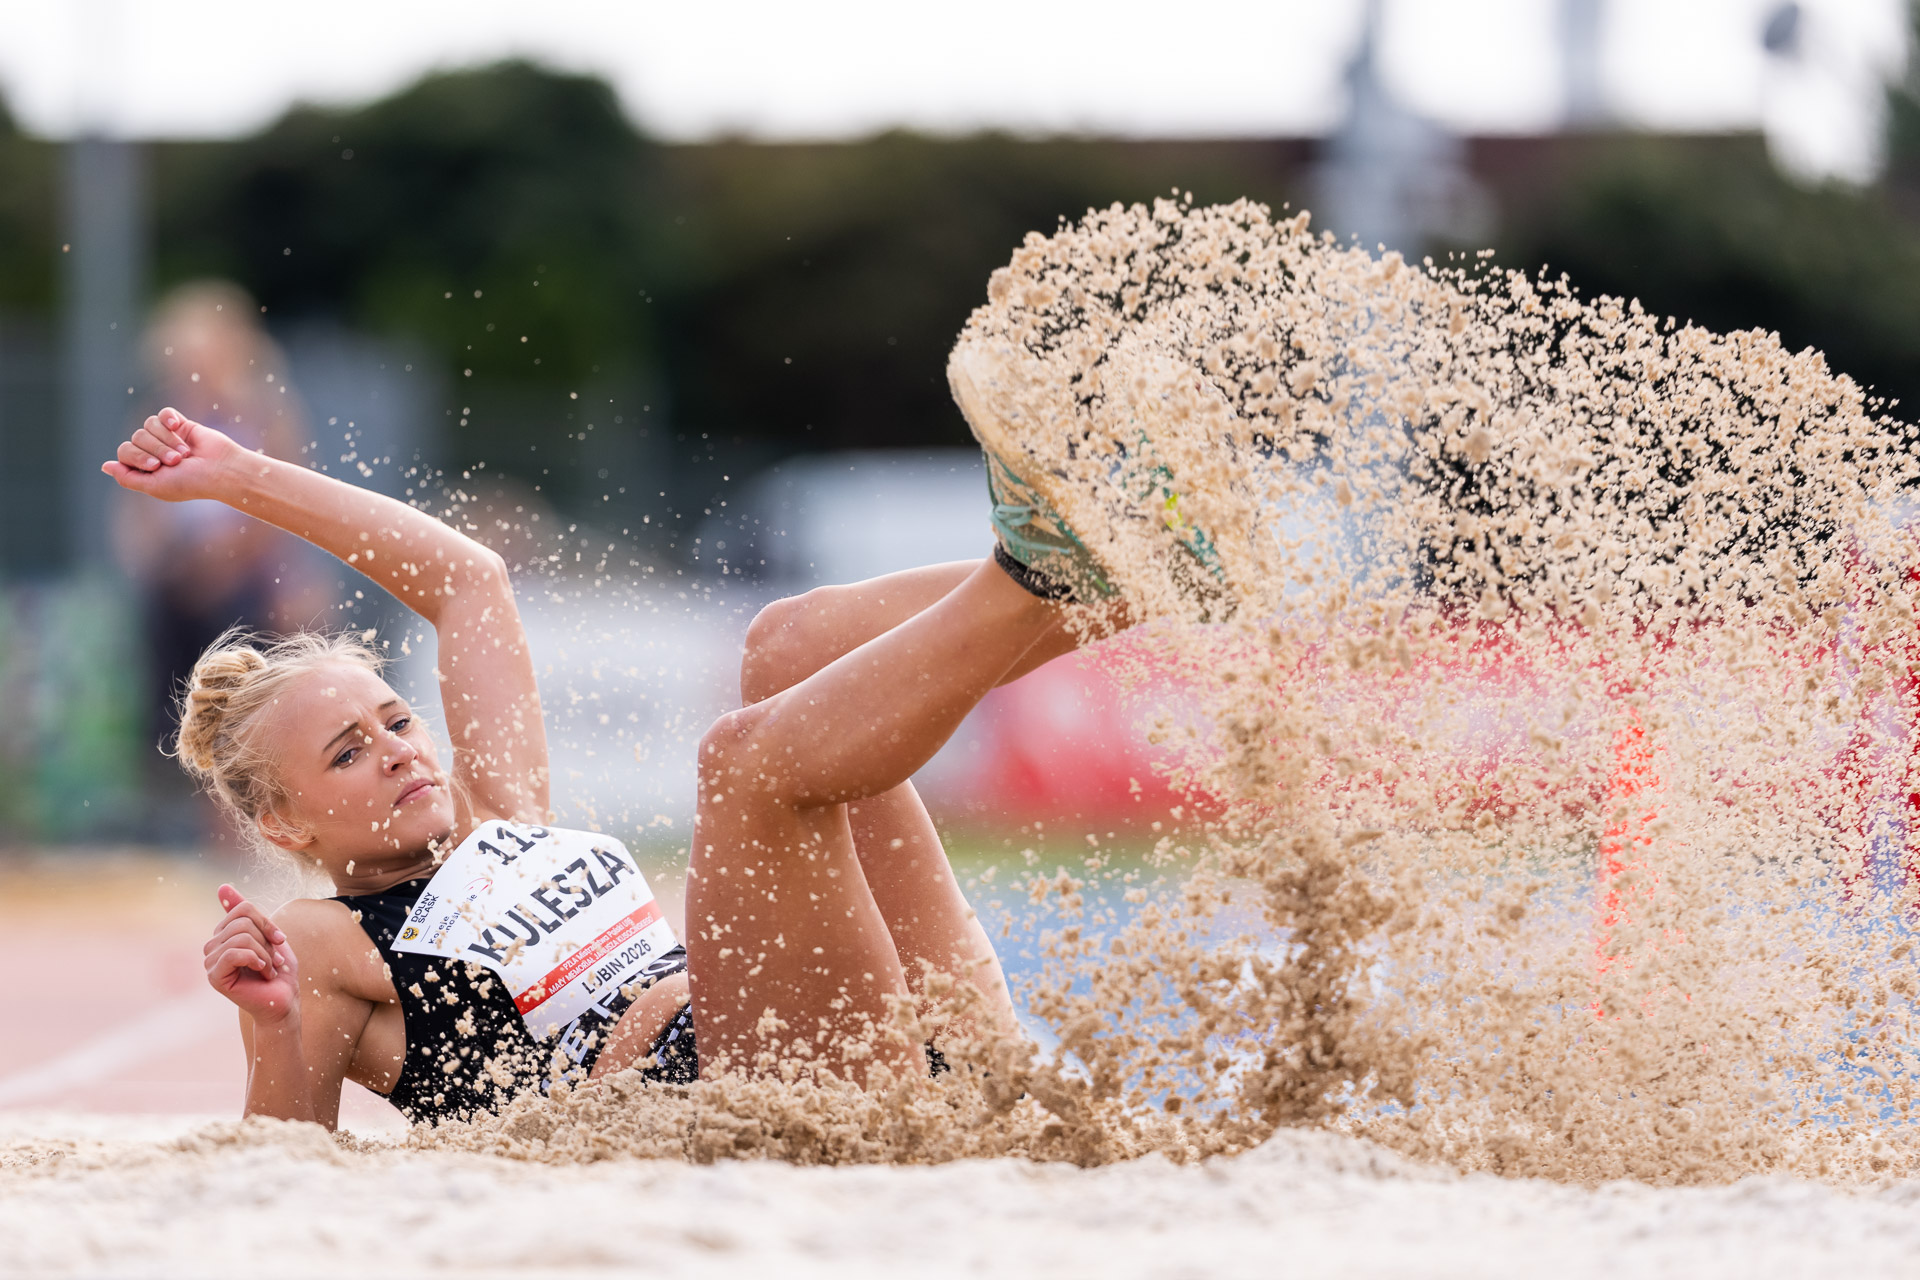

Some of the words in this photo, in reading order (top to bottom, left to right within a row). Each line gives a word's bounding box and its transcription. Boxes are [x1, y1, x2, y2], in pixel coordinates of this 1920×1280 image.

[410, 892, 432, 923] DOLNY
[467, 846, 635, 966] KULESZA
[428, 915, 450, 945] Koeje
[563, 955, 580, 971] PZLA
[578, 936, 609, 959] Mistrztwa
[620, 938, 652, 965] 2026
[548, 977, 568, 995] MAŁY
[566, 957, 596, 982] MEMORIAŁ
